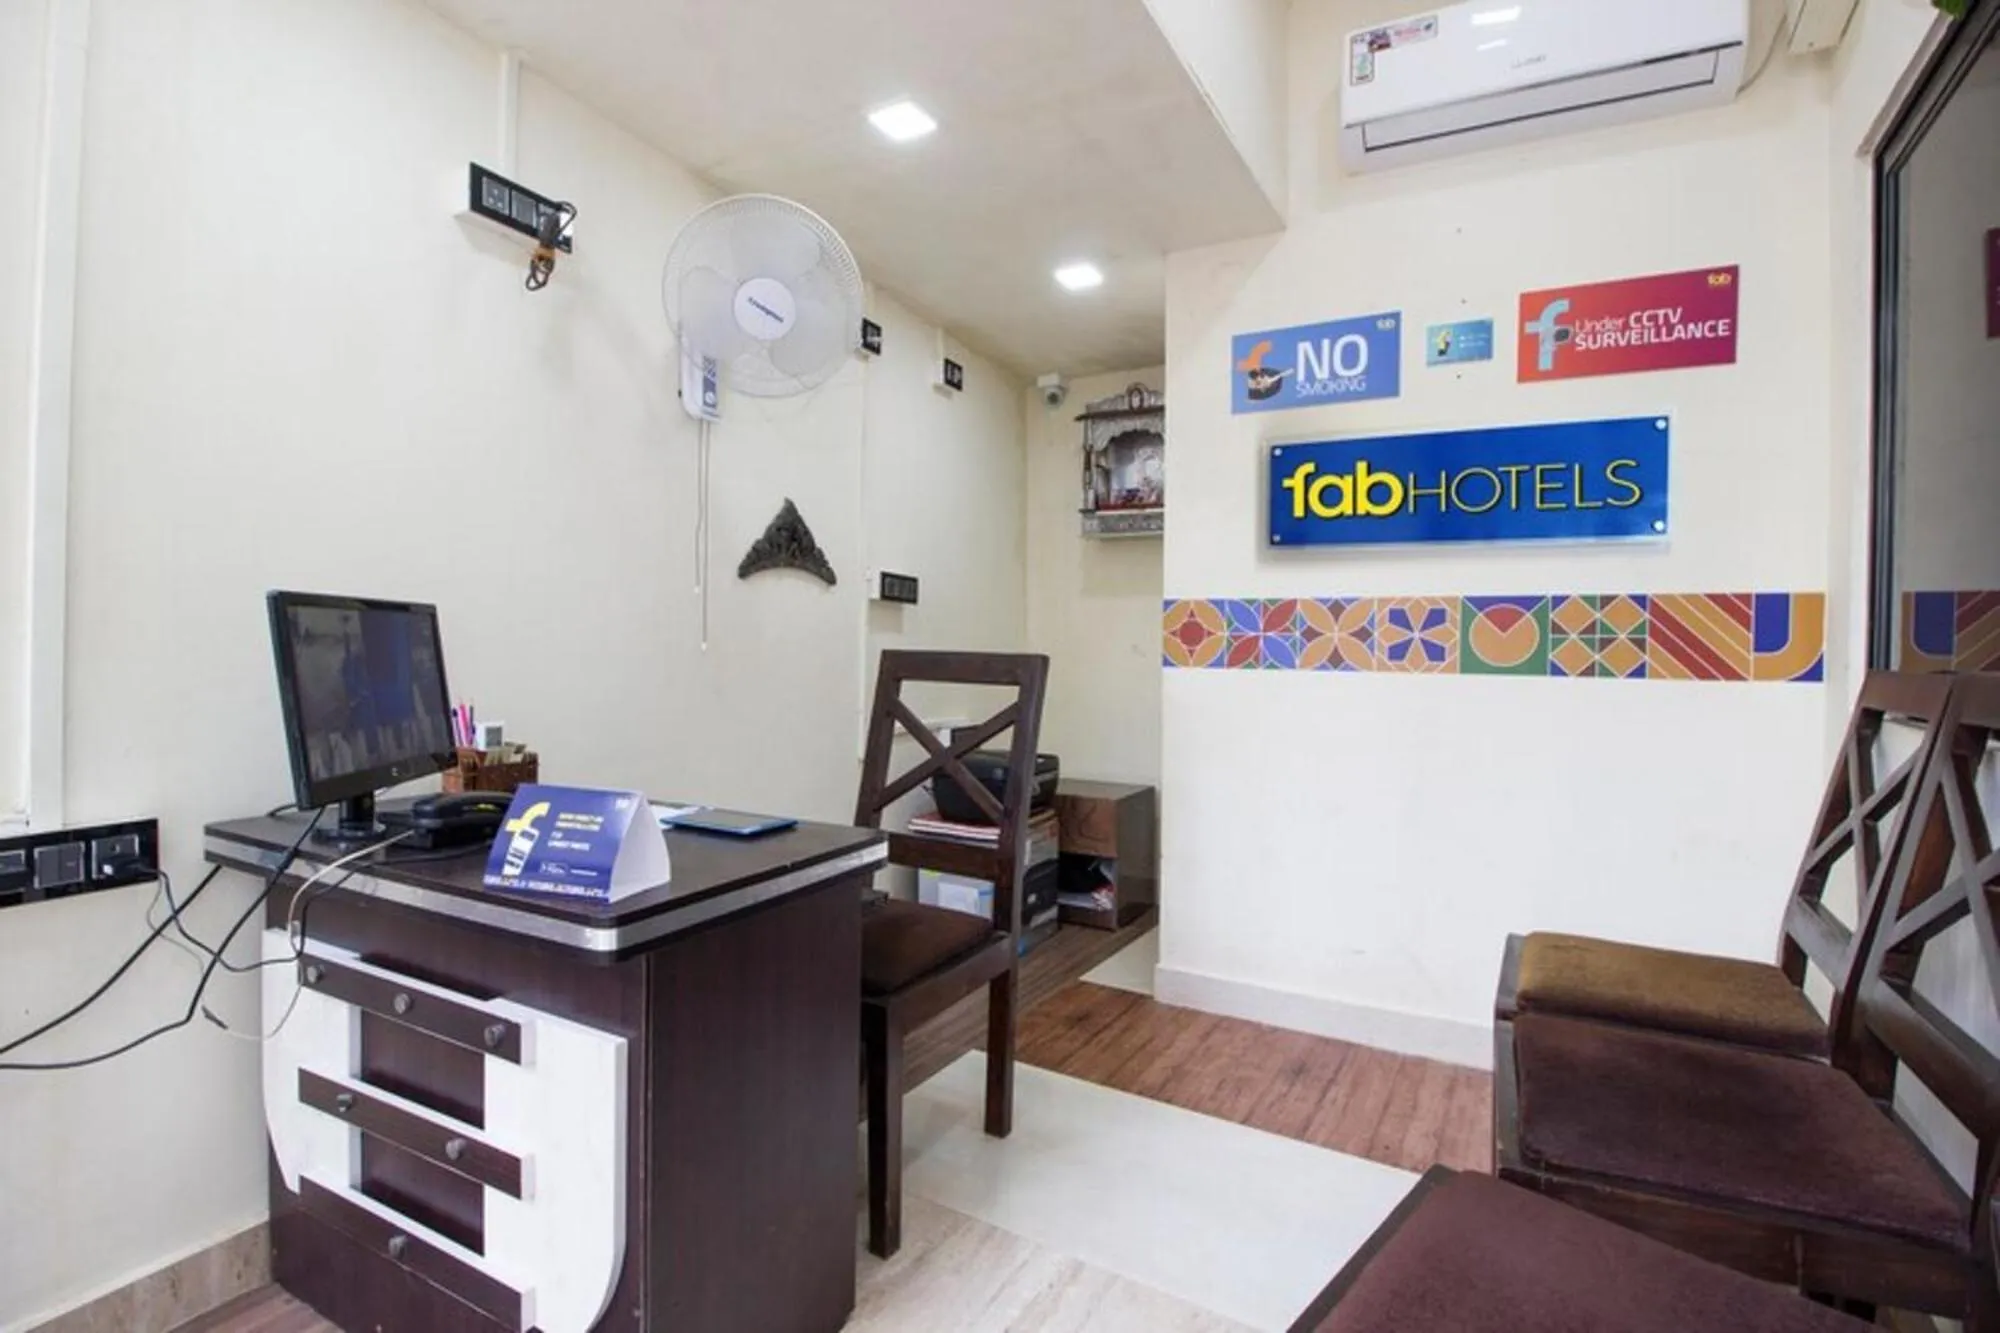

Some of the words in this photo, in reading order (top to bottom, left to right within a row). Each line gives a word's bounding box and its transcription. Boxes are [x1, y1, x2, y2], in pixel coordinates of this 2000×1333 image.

[1575, 317, 1626, 334] Under
[1629, 308, 1682, 329] CCTV
[1575, 319, 1731, 350] SURVEILLANCE
[1297, 334, 1369, 382] NO
[1296, 376, 1367, 398] SMOKING
[1282, 460, 1643, 518] fabHOTELS
